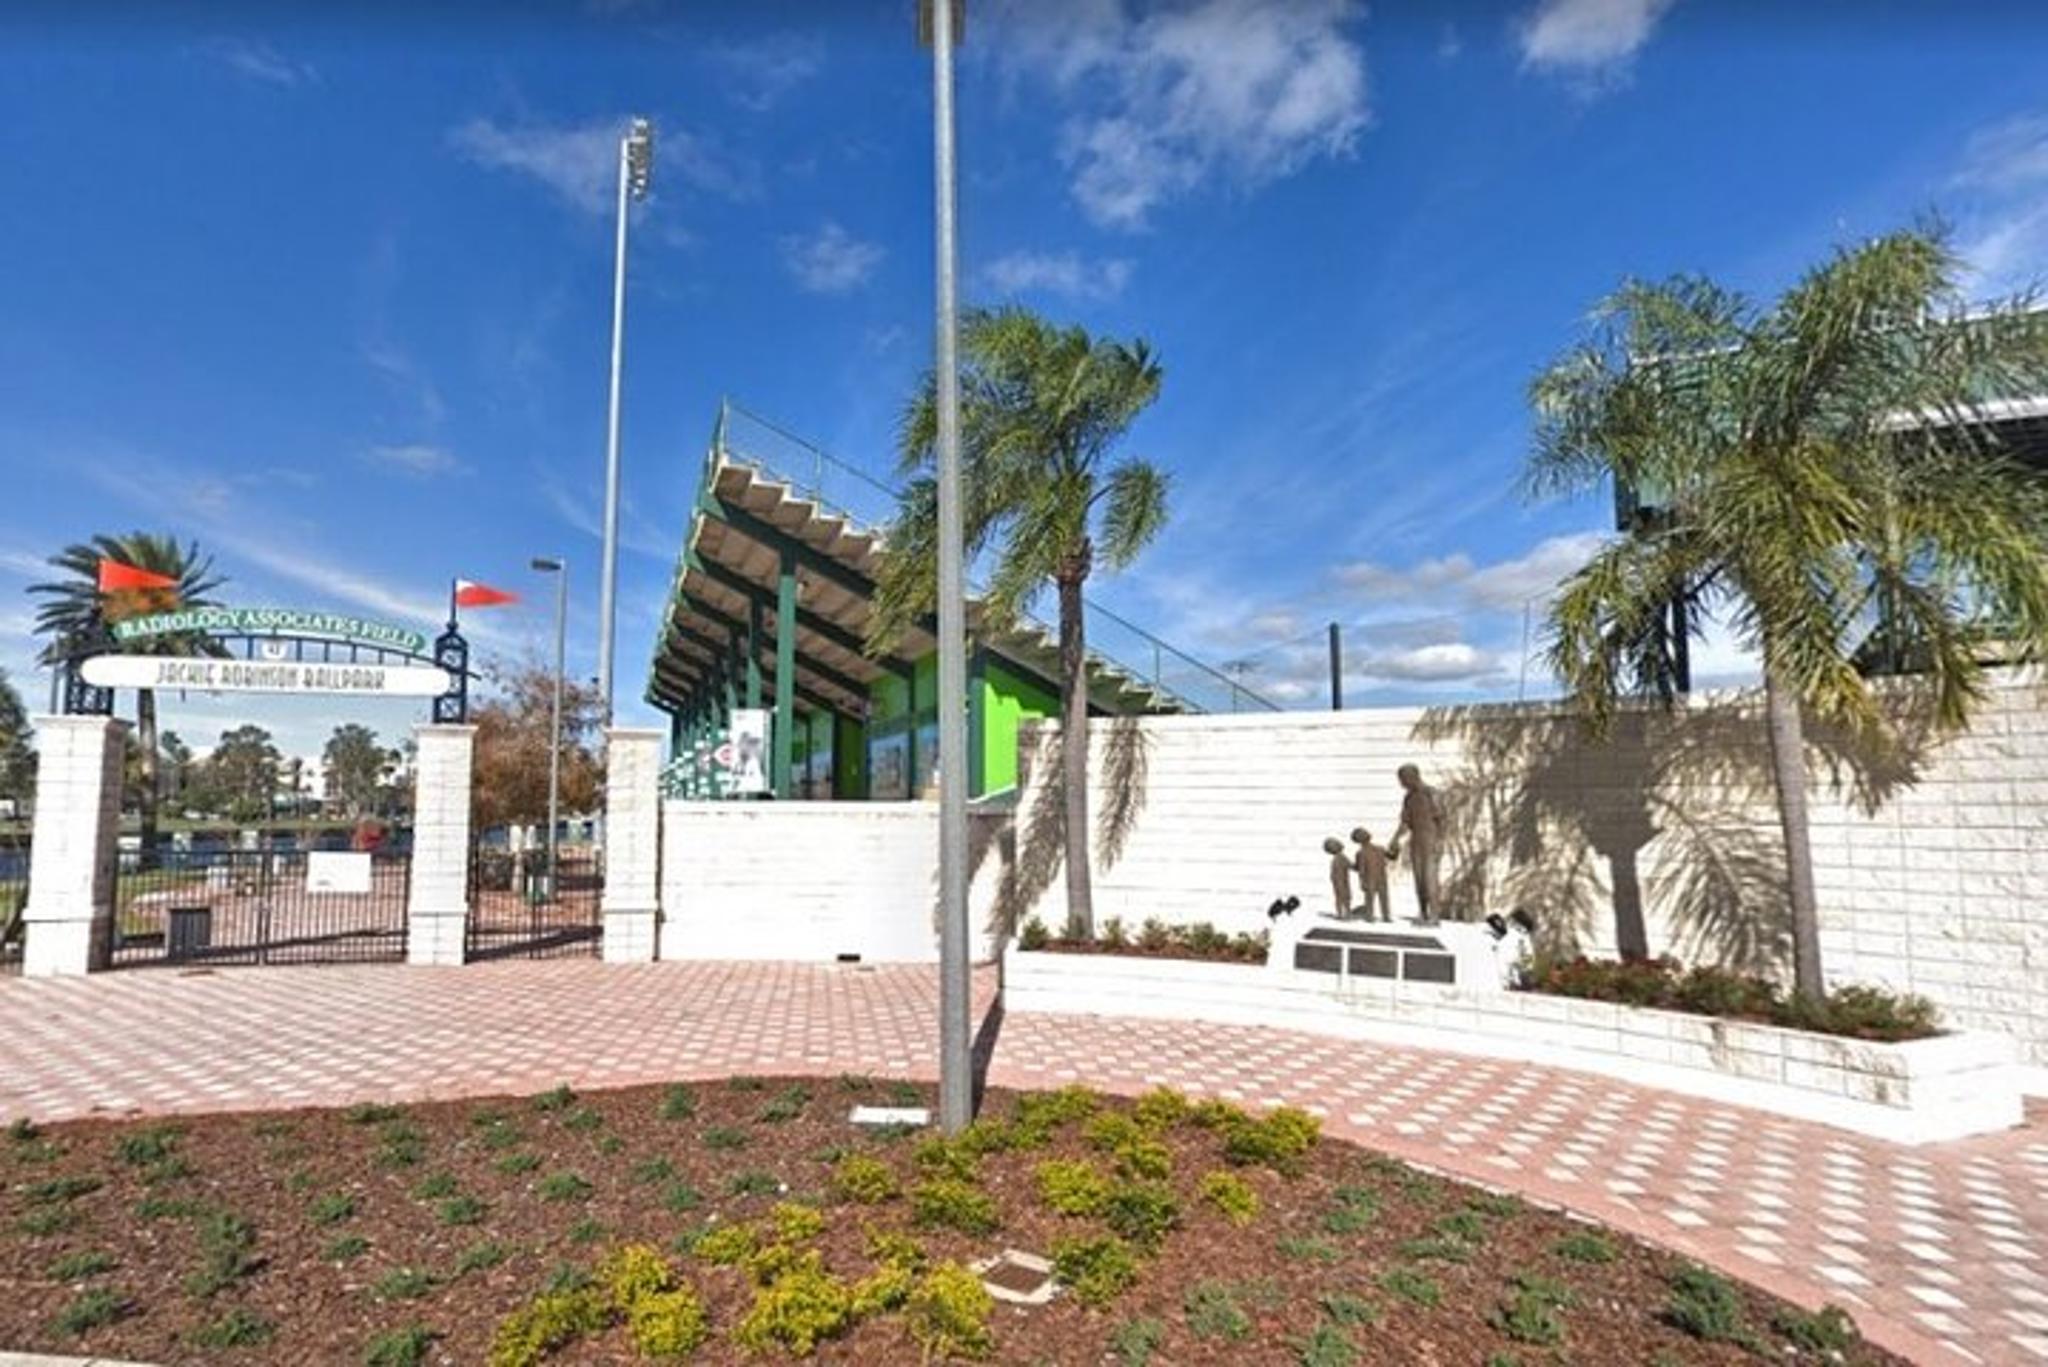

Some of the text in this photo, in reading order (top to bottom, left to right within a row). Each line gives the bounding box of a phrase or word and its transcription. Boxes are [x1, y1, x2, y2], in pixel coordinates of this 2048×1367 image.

[121, 611, 417, 647] RADIOLOGY ASSOCIATES FIELD
[156, 663, 385, 690] JACKIE ROBINSON BALLPARK
